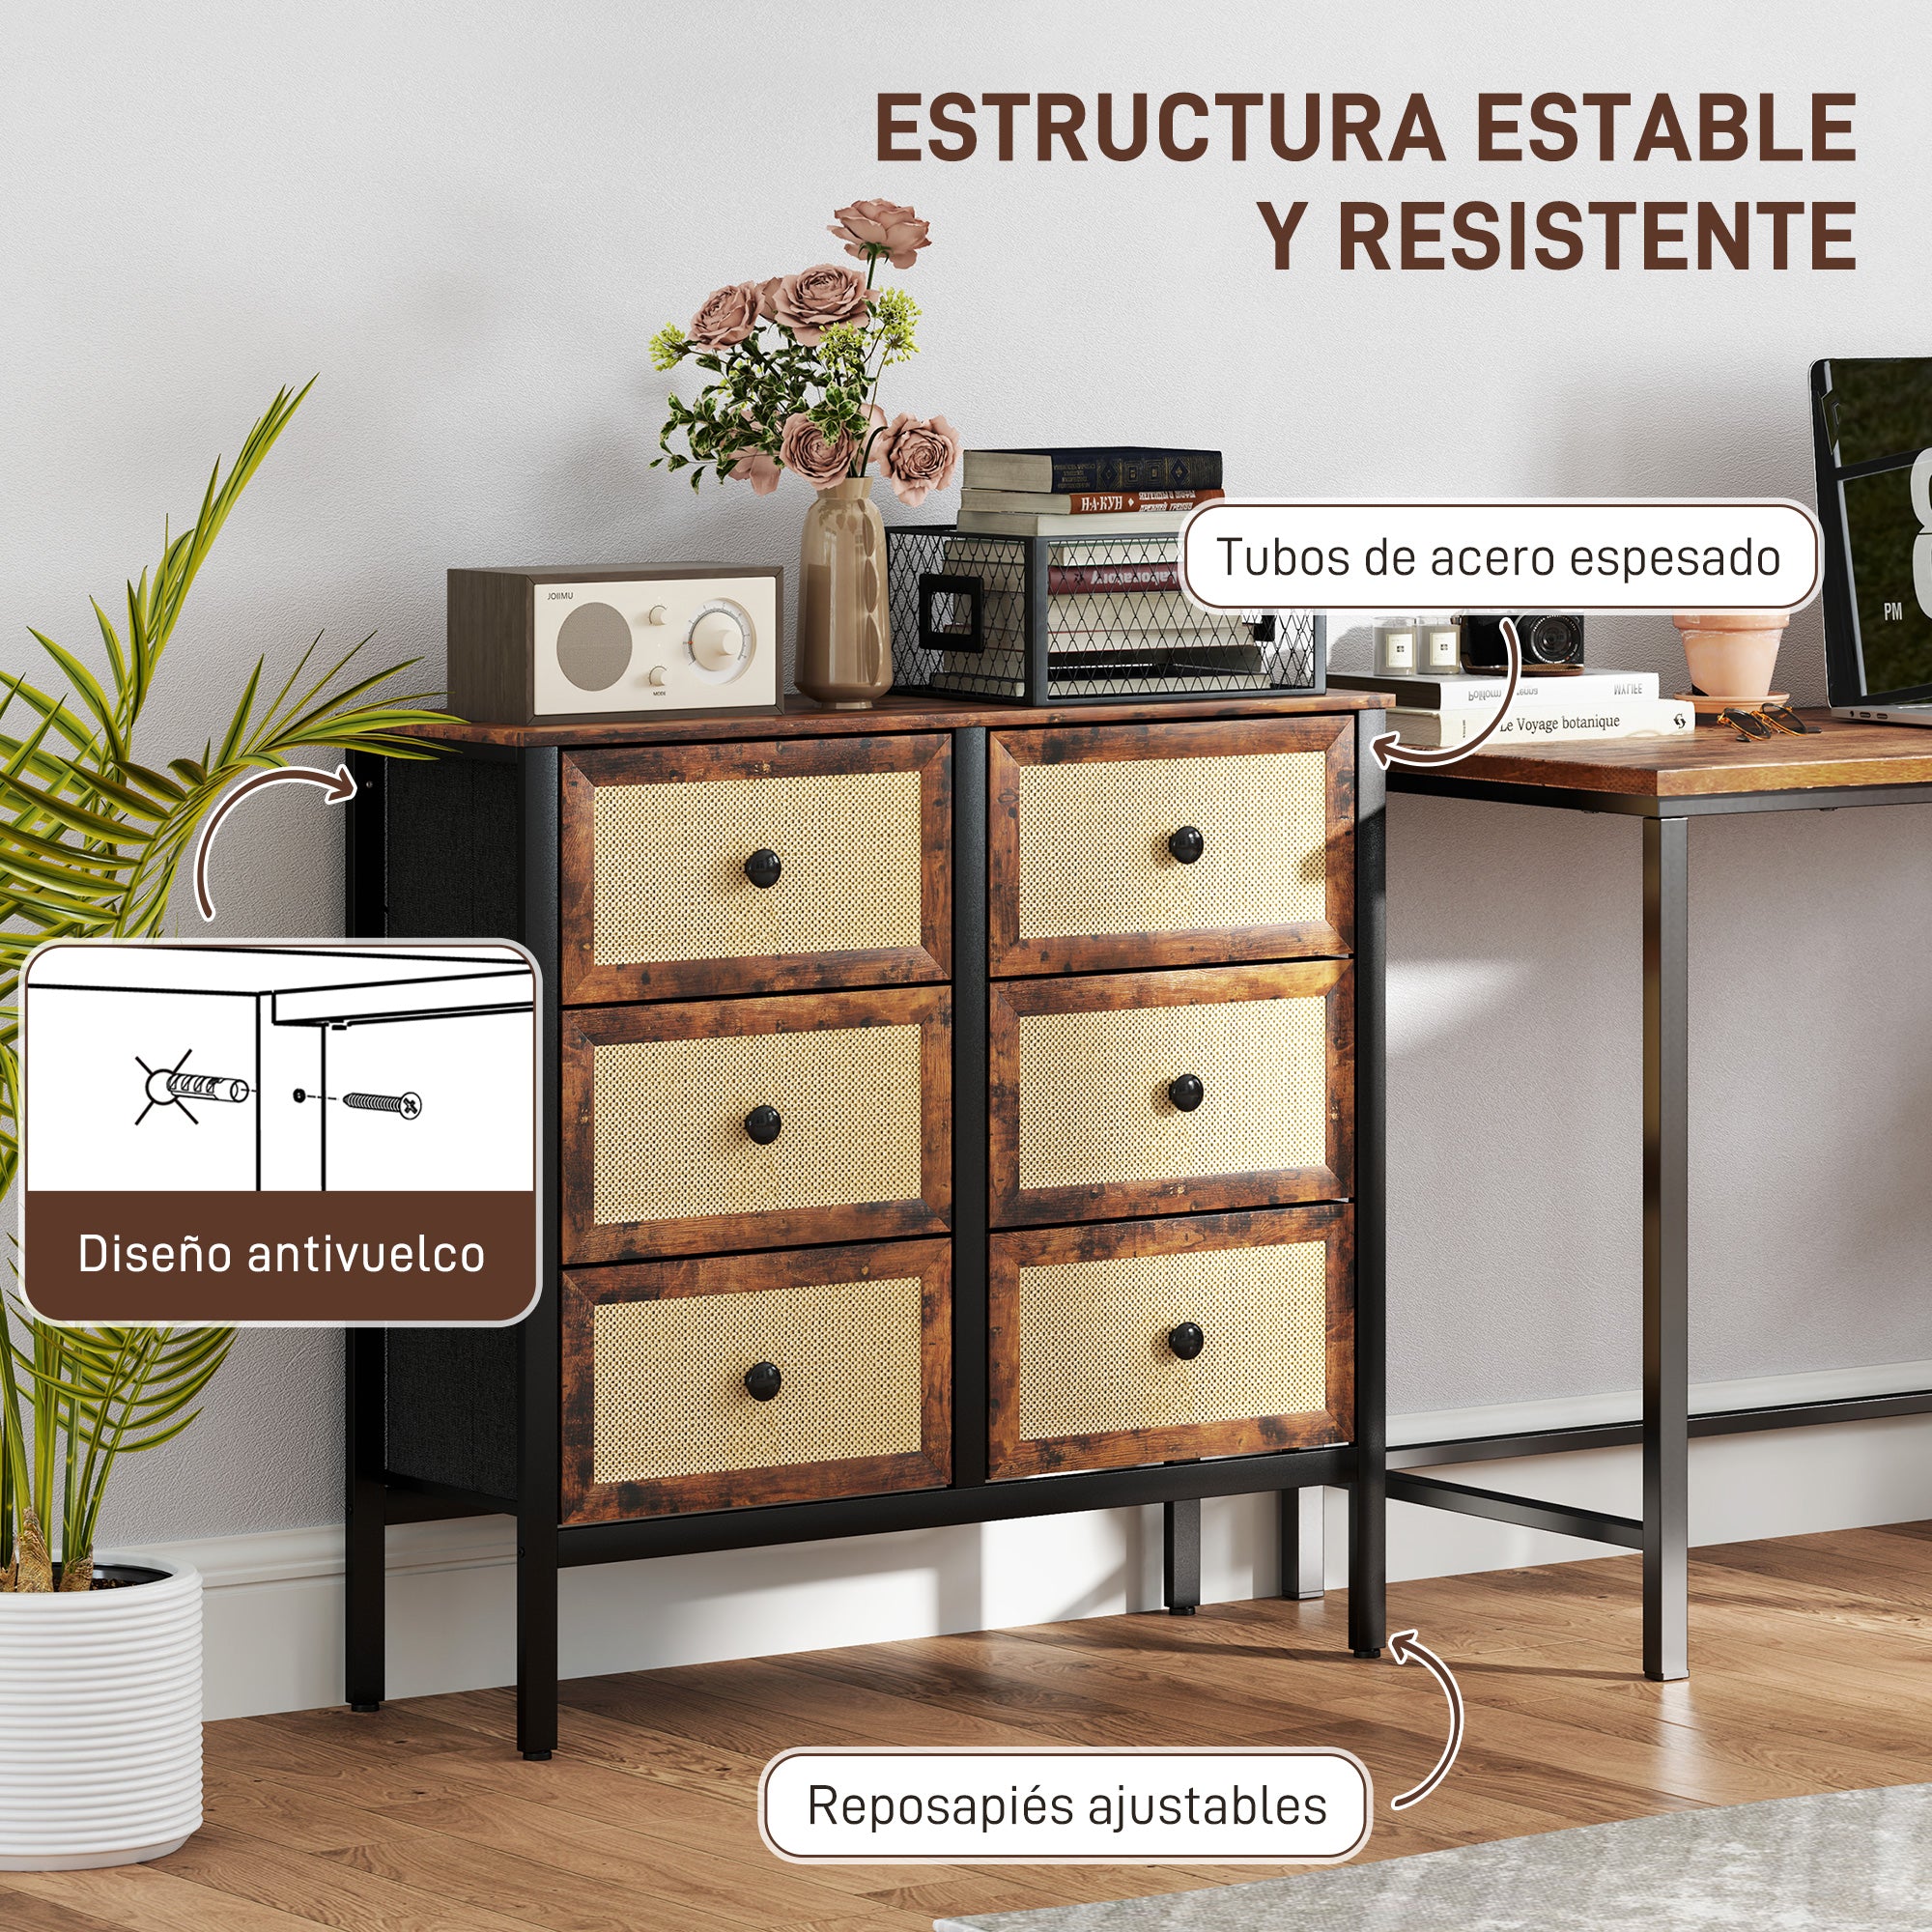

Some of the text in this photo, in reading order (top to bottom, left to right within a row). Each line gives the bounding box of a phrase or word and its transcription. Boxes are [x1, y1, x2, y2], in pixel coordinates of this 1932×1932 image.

[1090, 570, 1178, 585] Laboratory
[1884, 602, 1903, 621] PM
[1516, 718, 1559, 735] Voyage
[1561, 714, 1621, 731] botanique
